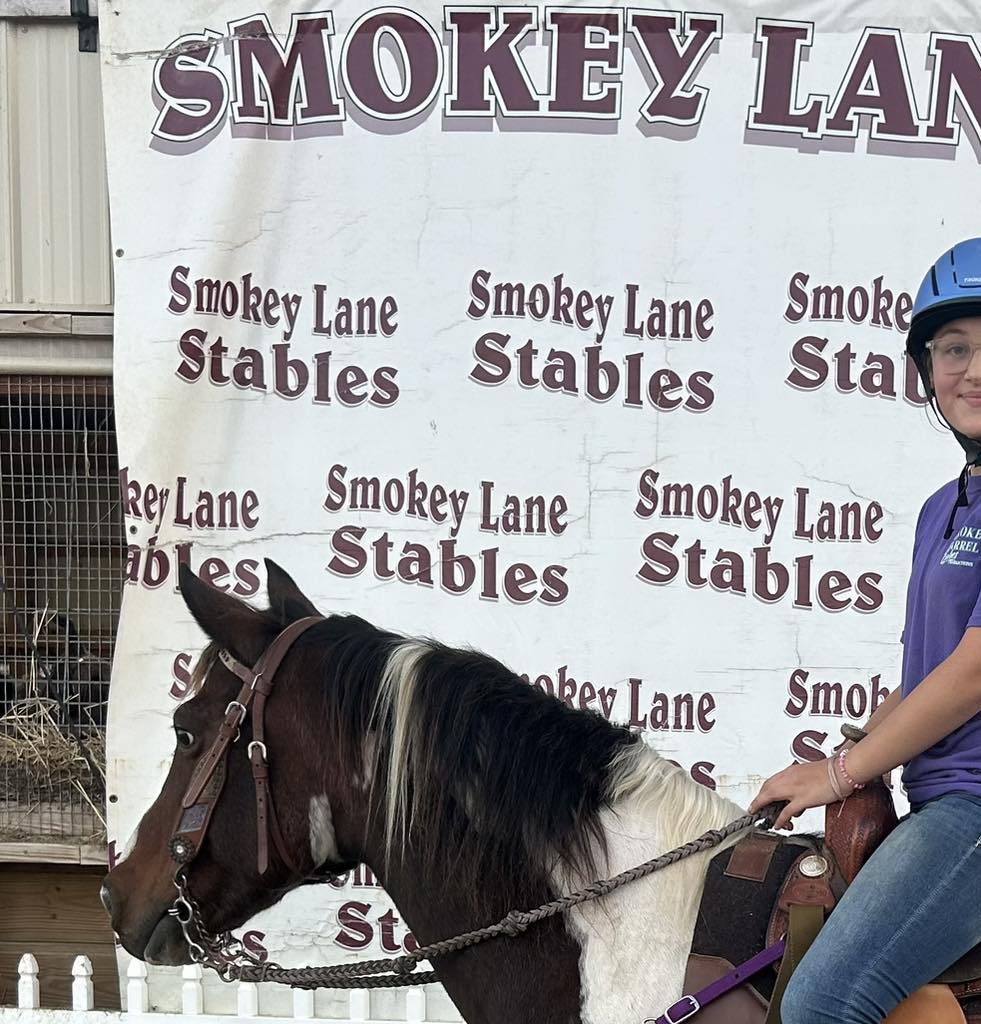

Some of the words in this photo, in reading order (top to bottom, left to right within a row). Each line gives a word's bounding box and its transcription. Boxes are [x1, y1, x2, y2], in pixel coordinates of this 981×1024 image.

[151, 5, 723, 145] SMOKEY
[168, 265, 302, 340] Smokey
[313, 284, 398, 336] Lane
[467, 269, 614, 342] Smokey
[625, 284, 714, 340] Lane
[784, 271, 914, 332] Smoke
[176, 329, 399, 405] Stables
[469, 333, 714, 411] Stables
[119, 467, 170, 534] key
[174, 476, 260, 530] Lane
[324, 464, 469, 538] Smokey
[480, 481, 568, 535] Lane
[635, 469, 784, 543] Smokey
[794, 487, 884, 541] Lane
[327, 526, 569, 604] Stables
[637, 532, 884, 612] Stables
[628, 678, 717, 733] Lane
[785, 668, 891, 719] Smok
